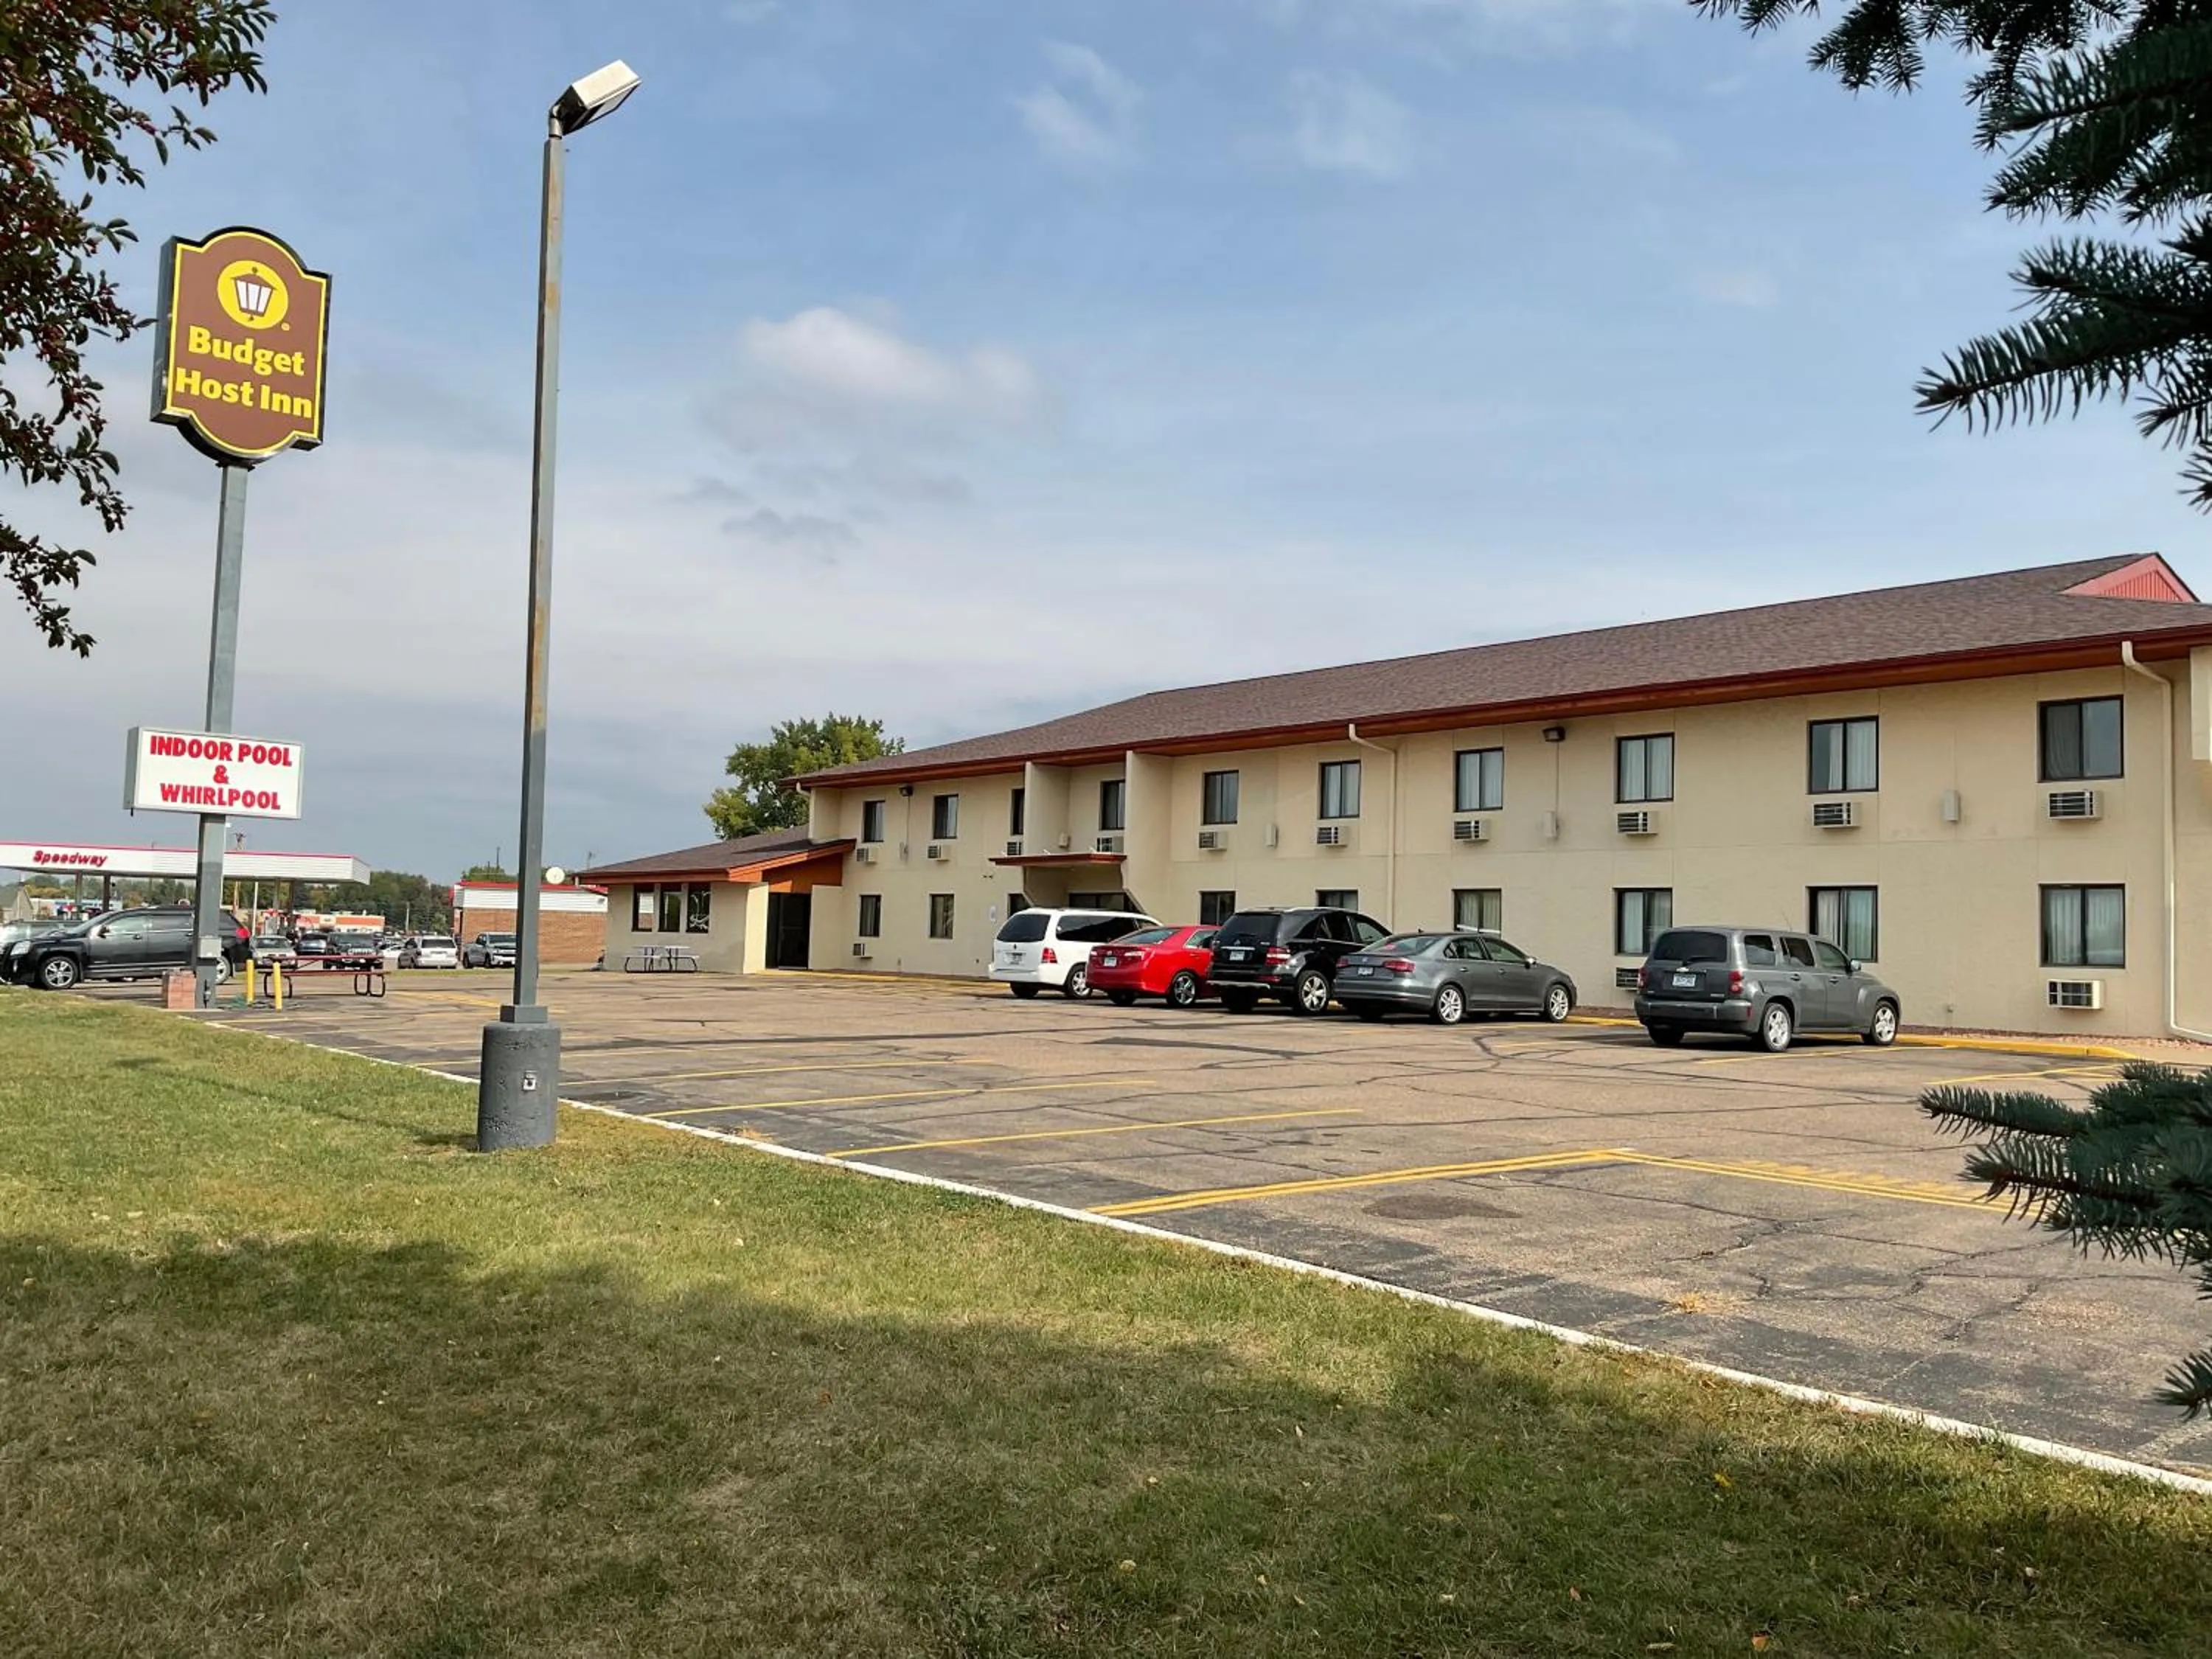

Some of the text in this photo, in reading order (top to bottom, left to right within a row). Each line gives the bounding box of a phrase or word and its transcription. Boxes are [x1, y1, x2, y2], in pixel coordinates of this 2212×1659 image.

[188, 325, 305, 376] Budget
[175, 367, 313, 419] Host Inn
[150, 735, 292, 767] INDOOR POOL
[213, 765, 230, 785] &
[160, 783, 281, 810] WHIRLPOOL
[32, 850, 108, 867] Speedway
